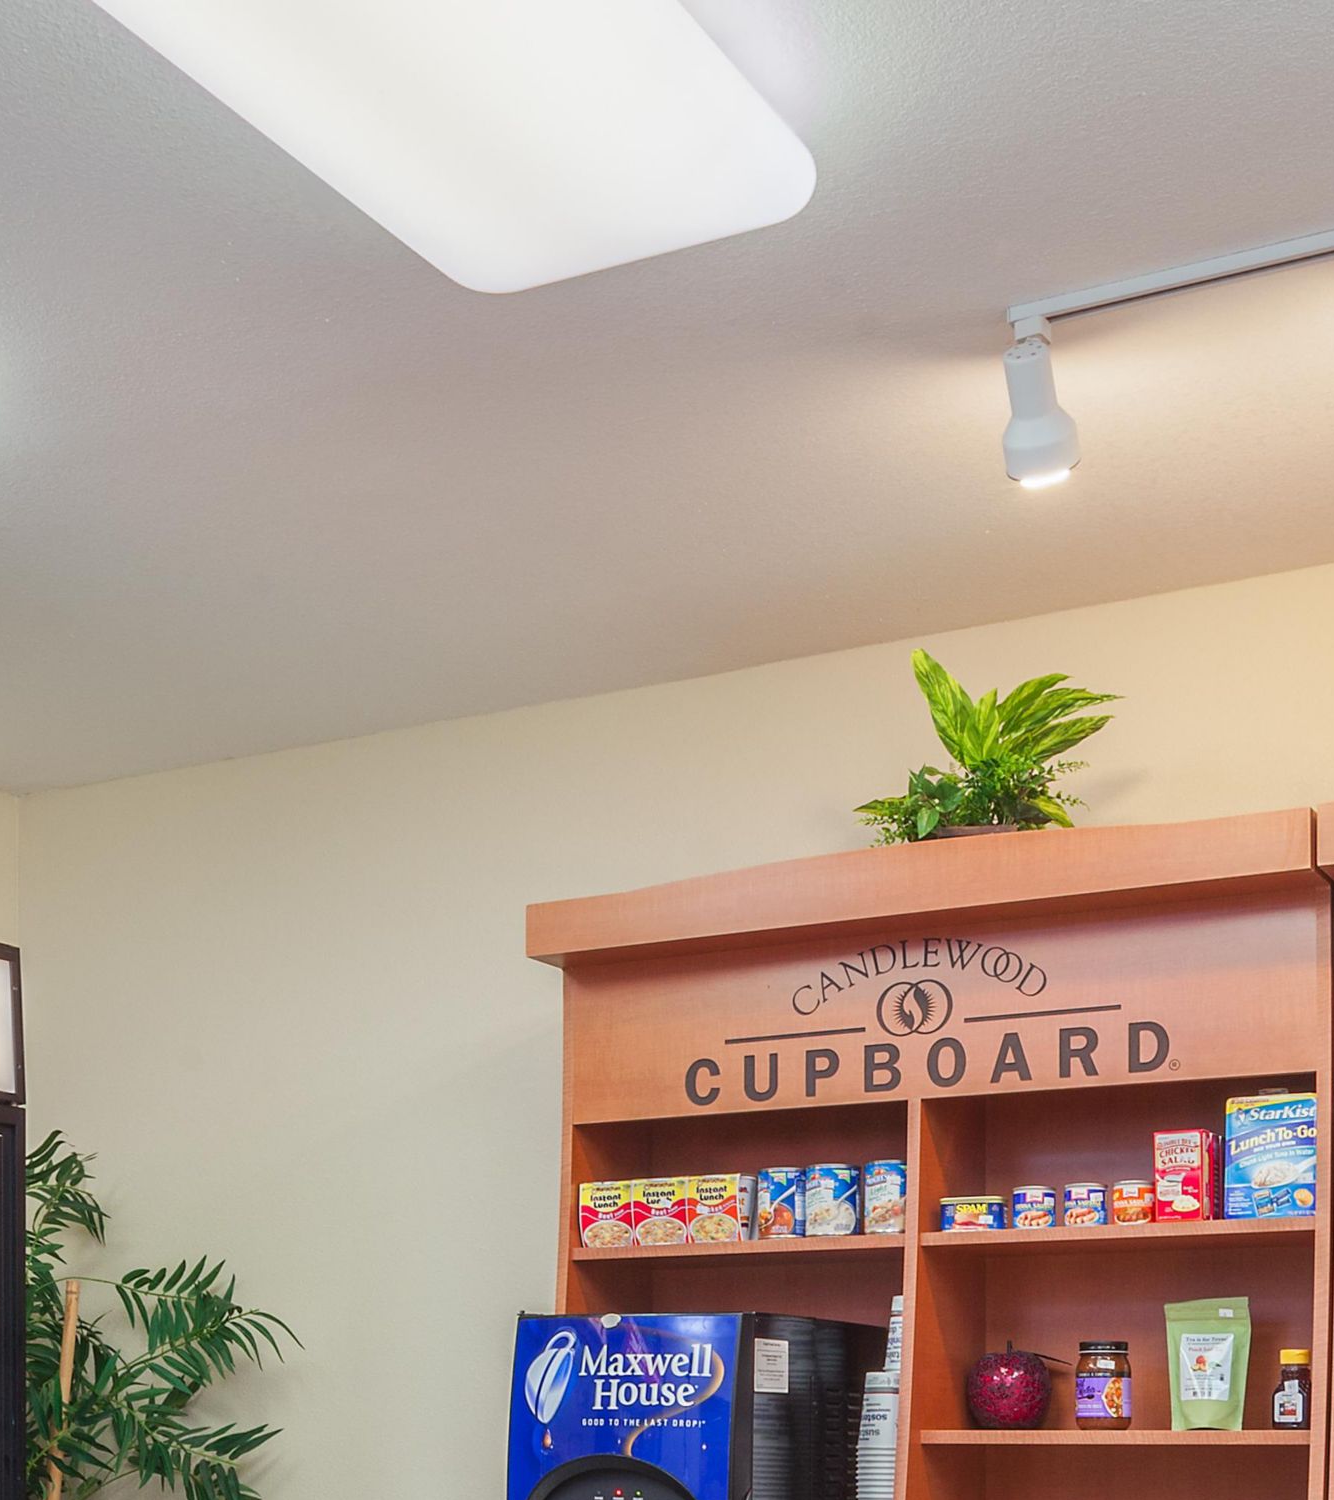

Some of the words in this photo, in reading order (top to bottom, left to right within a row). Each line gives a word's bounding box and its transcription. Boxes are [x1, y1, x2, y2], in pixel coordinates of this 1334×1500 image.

[791, 937, 1048, 1016] CANDLEWOOD
[684, 1021, 1170, 1106] CUPBOARD
[1248, 1103, 1316, 1121] StarKist
[1229, 1128, 1278, 1156] Lunch
[642, 1190, 677, 1200] Instant
[696, 1185, 728, 1195] Instant
[589, 1193, 622, 1202] Instant
[699, 1193, 725, 1201] Lunch
[593, 1201, 620, 1209] Lunch
[956, 1203, 988, 1214] SPAM
[578, 1343, 713, 1379] Maxwell
[592, 1379, 698, 1411] House
[581, 1417, 607, 1428] GOOD
[609, 1417, 621, 1428] TO
[623, 1417, 642, 1428] THE
[644, 1418, 670, 1428] LAST
